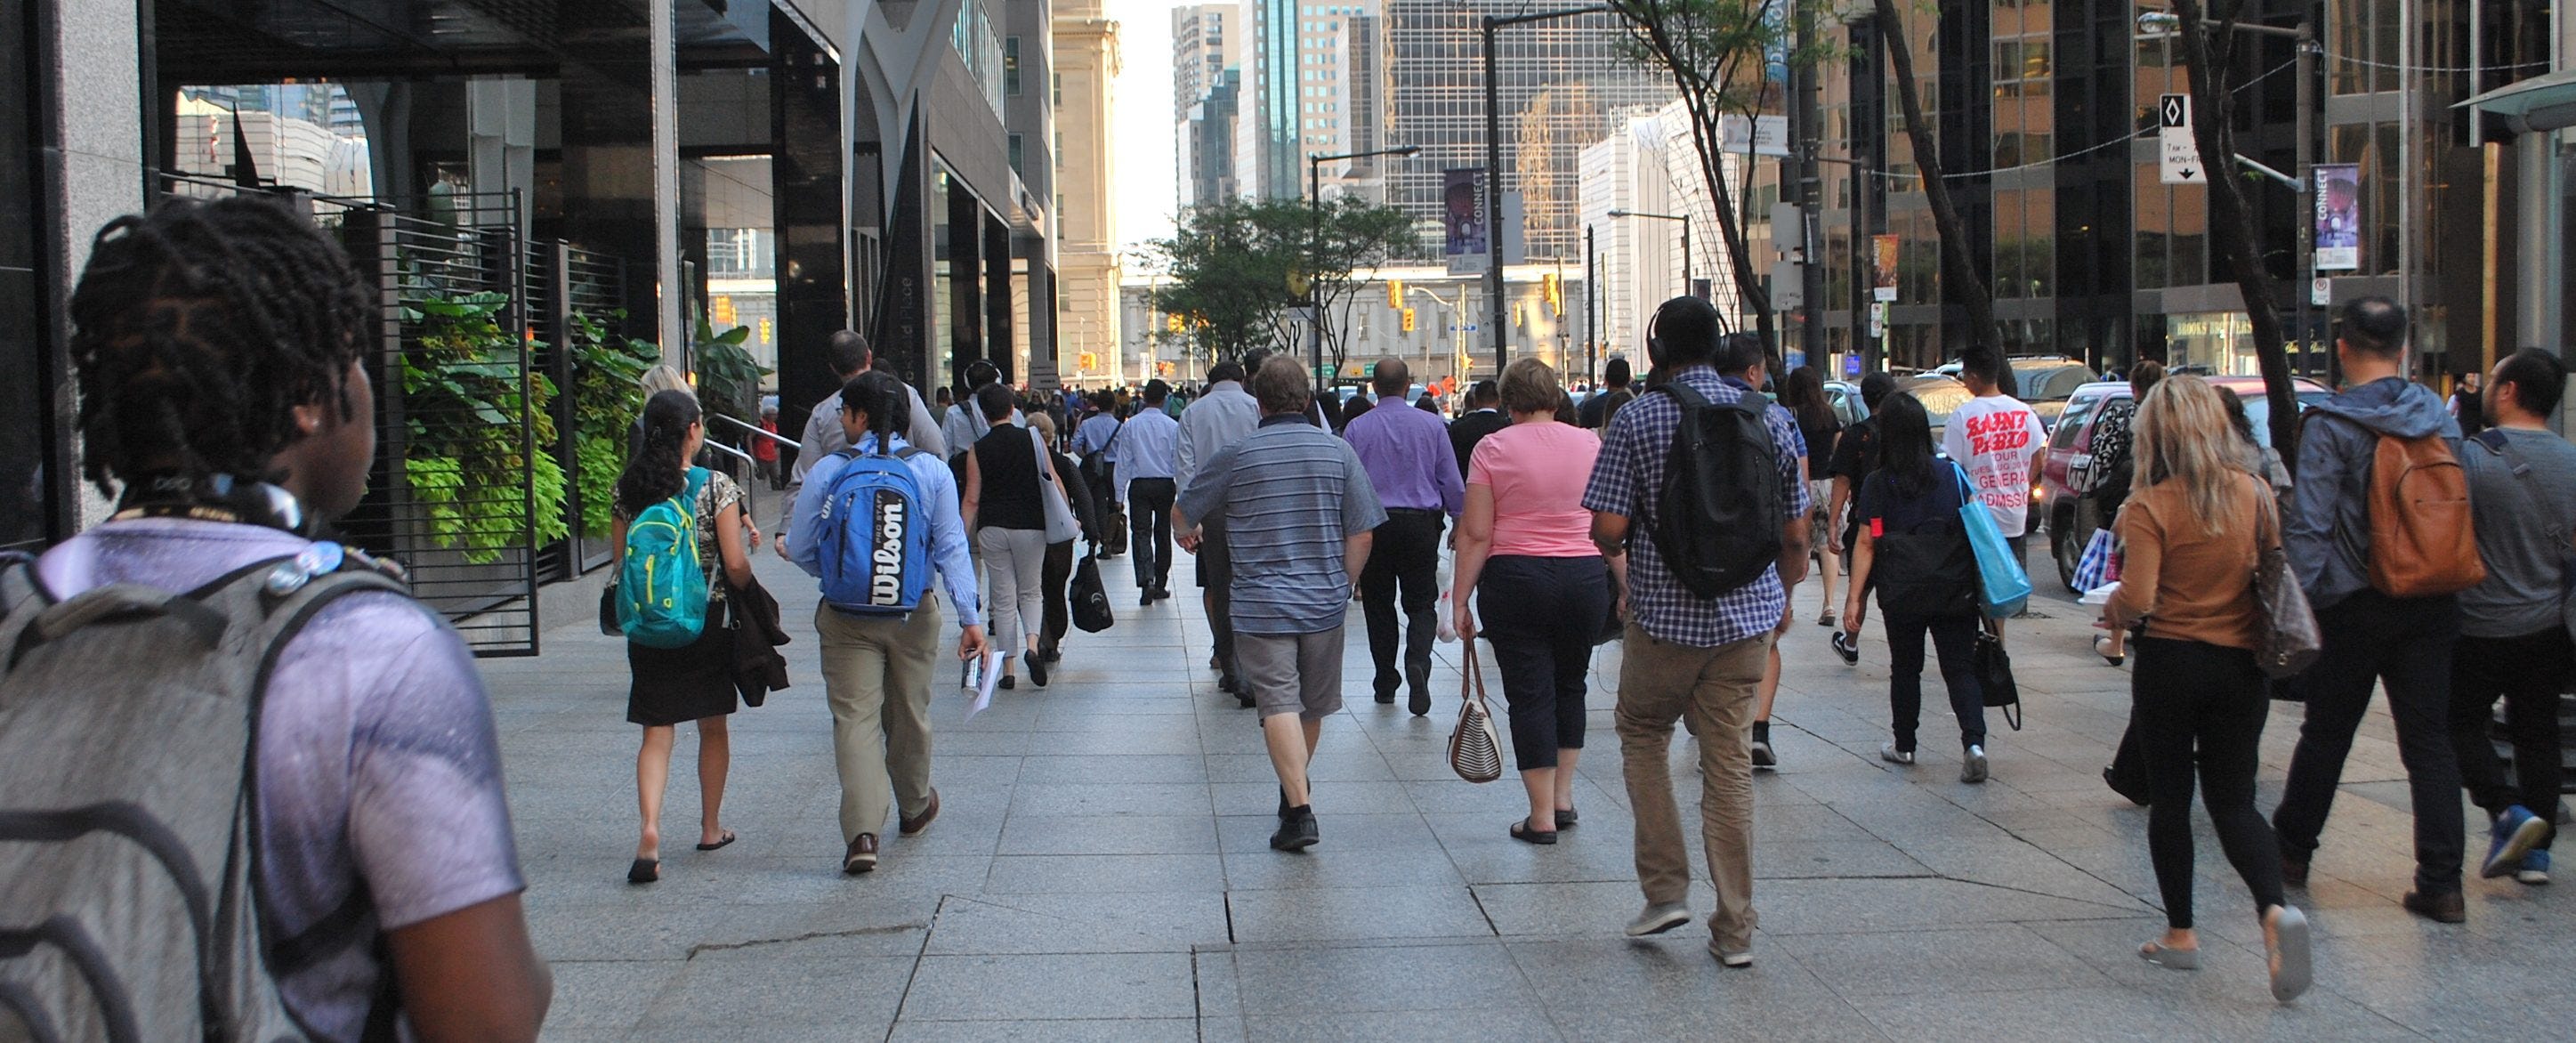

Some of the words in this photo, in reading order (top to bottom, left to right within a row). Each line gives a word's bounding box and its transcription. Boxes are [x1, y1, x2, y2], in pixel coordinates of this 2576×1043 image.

[2169, 156, 2199, 164] MON-F
[1474, 172, 1483, 225] CONNECT
[2317, 168, 2328, 221] CONNECT
[2177, 321, 2207, 336] BROOKS
[2209, 321, 2253, 335] BROERS
[1992, 451, 2018, 462] OUR
[1995, 463, 2010, 471] UG
[1979, 471, 2028, 489] GENERA
